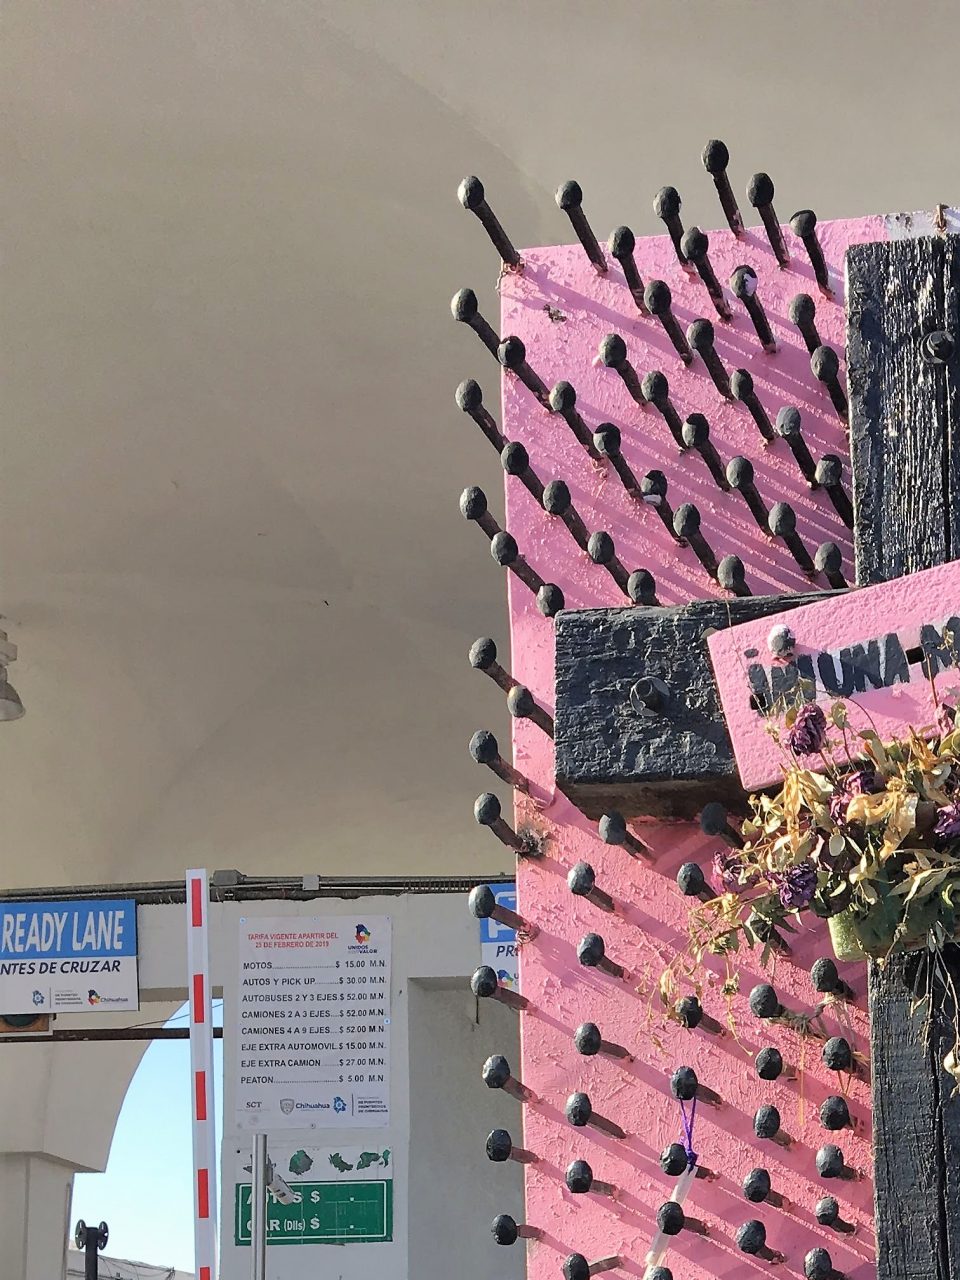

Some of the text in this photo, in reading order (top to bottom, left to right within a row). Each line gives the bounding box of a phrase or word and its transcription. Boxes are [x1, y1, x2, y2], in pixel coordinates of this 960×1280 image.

[817, 633, 910, 698] UNA
[1, 910, 124, 953] READY LANE
[38, 962, 57, 974] DE
[60, 960, 120, 974] CRUZAR
[243, 978, 270, 986] AUTOS
[310, 1190, 320, 1204] $
[310, 1218, 320, 1230] $
